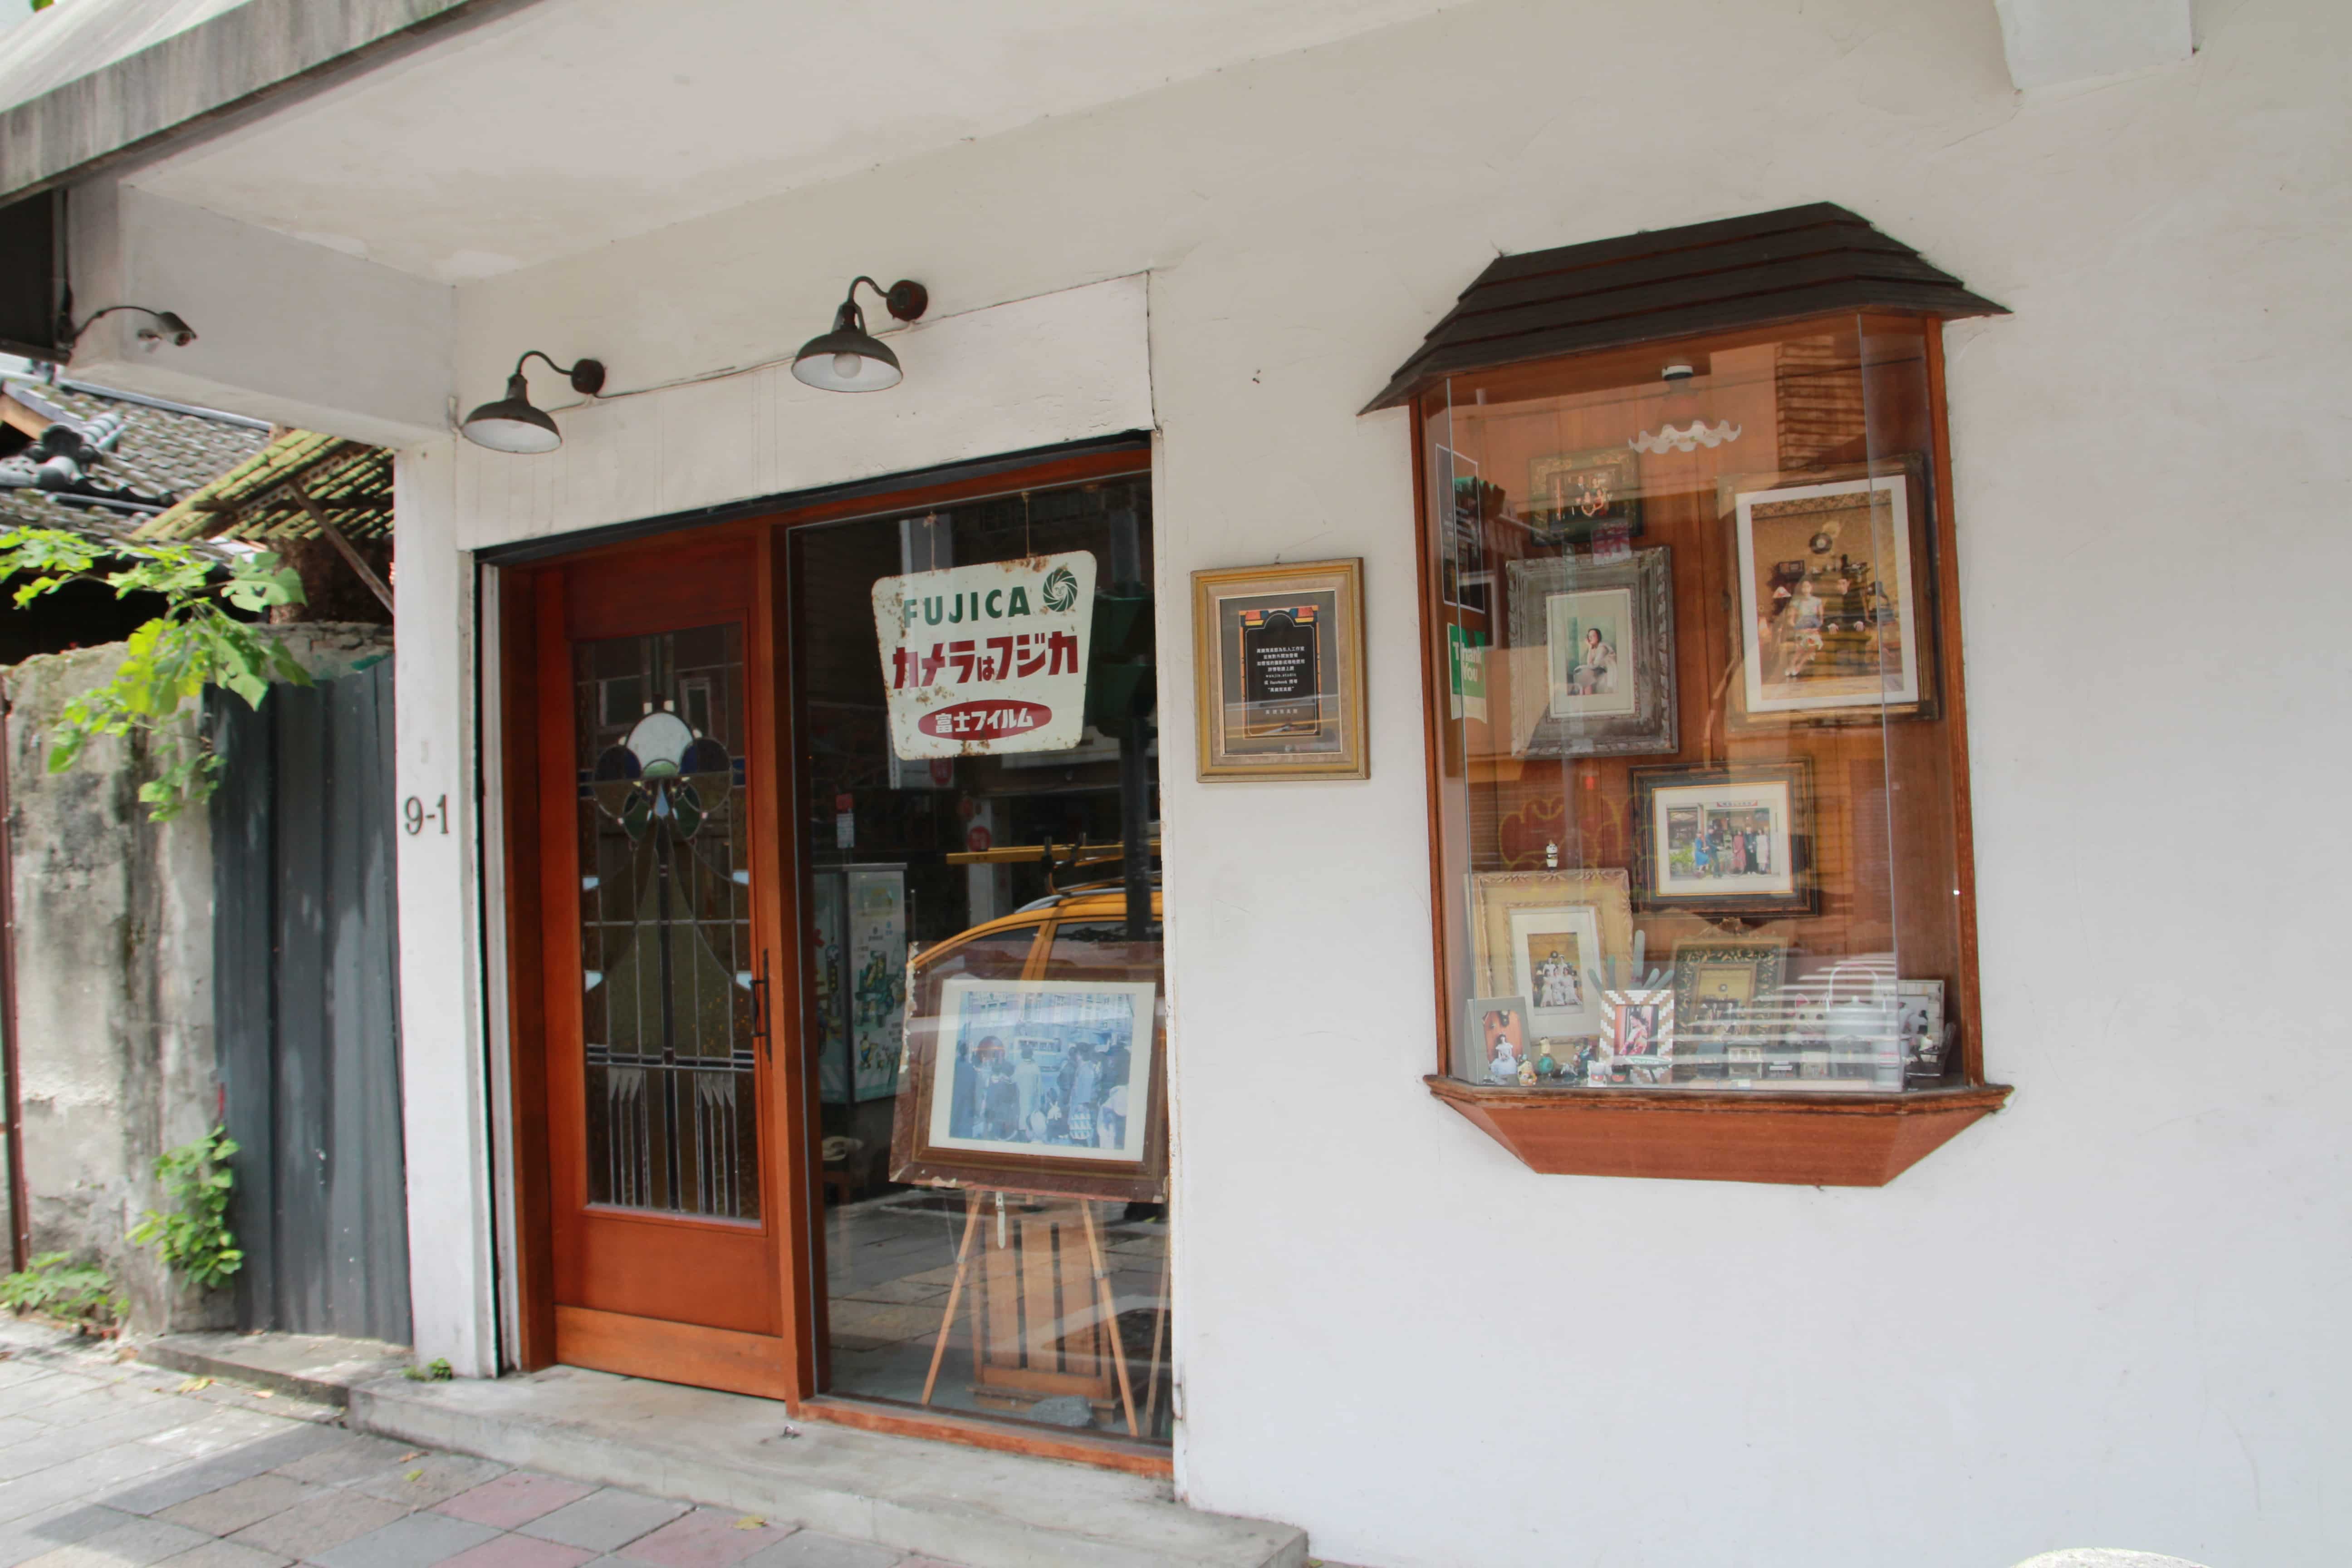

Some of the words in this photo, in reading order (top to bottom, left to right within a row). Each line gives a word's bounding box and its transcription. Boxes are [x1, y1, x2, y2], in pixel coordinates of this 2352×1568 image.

[904, 586, 1031, 628] FUJICA
[892, 631, 1078, 689] カメラはフジカ
[1452, 641, 1482, 665] Thank
[935, 708, 1034, 734] 富士フイルム
[404, 794, 449, 835] 9-1
